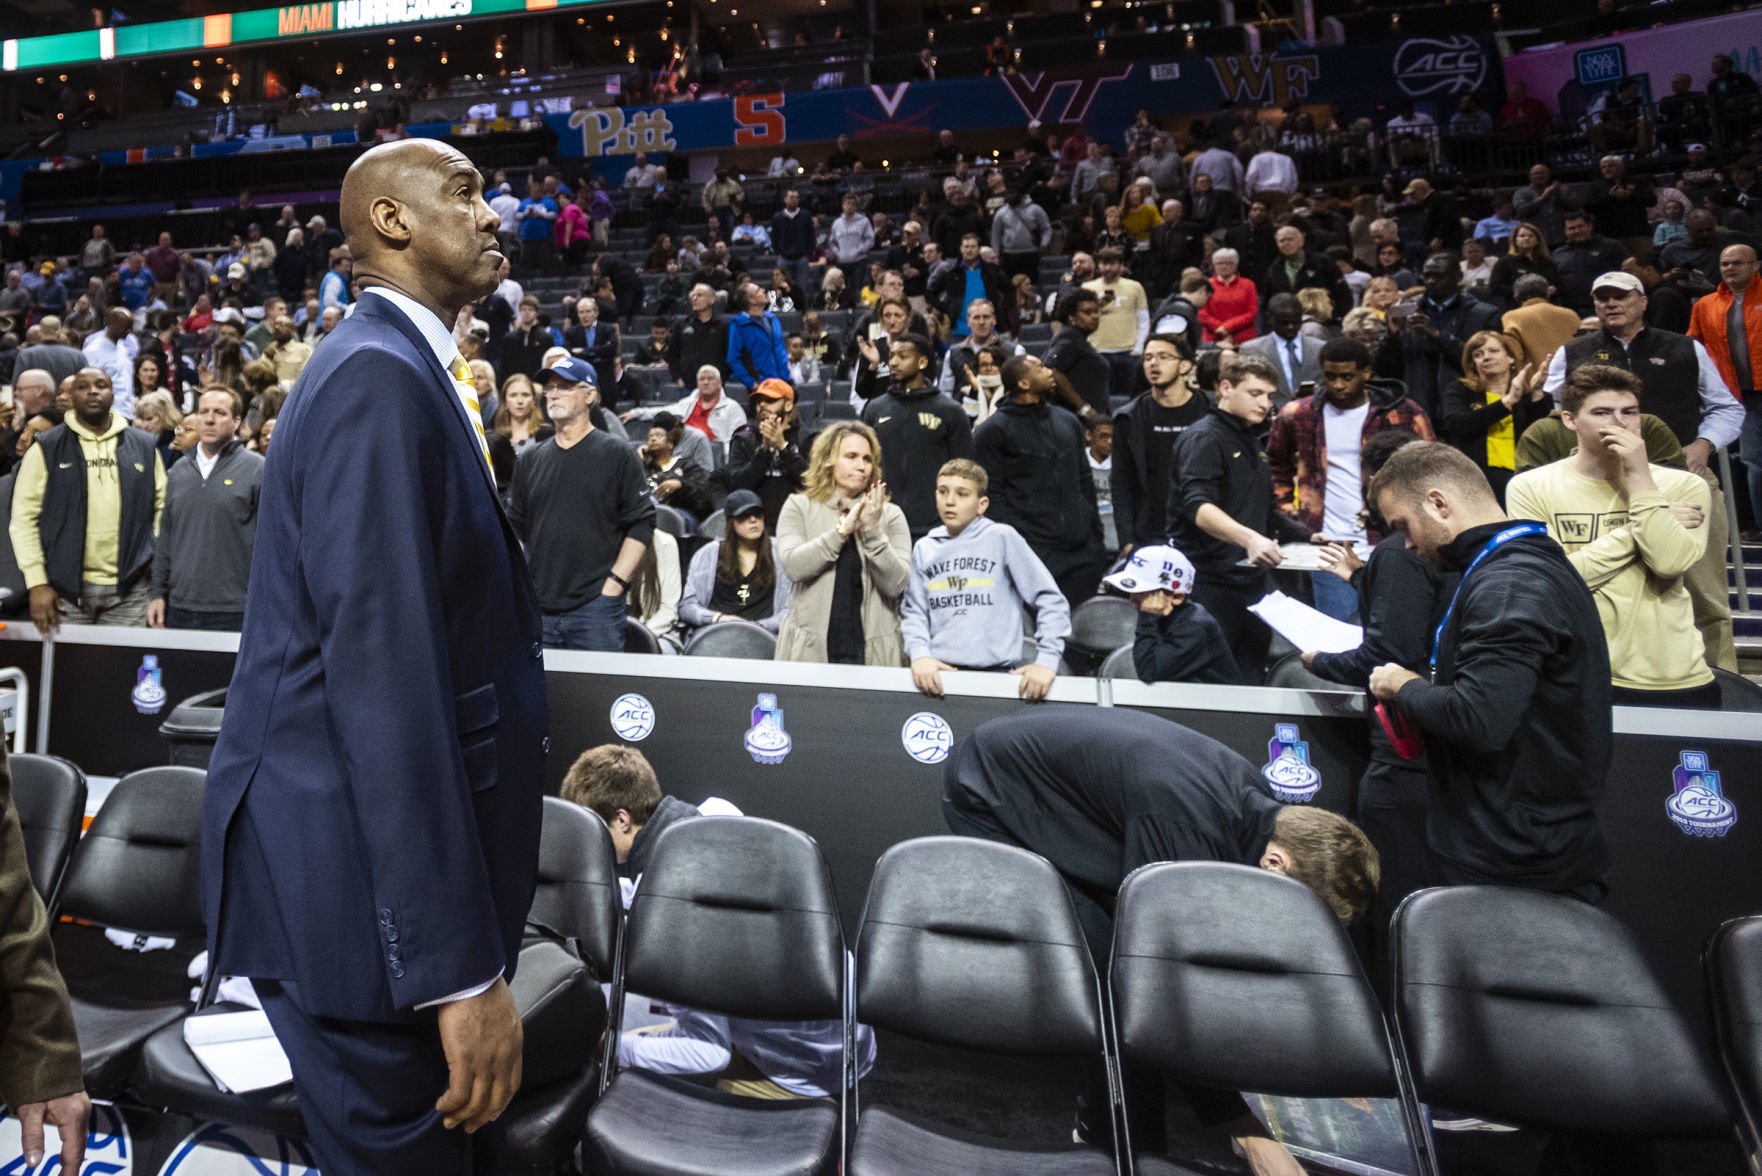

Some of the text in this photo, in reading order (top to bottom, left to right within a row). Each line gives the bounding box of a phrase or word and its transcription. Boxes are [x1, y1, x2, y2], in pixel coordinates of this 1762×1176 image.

[278, 3, 333, 36] MIAMI
[1405, 50, 1480, 73] ACC
[734, 92, 786, 146] S
[568, 106, 677, 157] Pitt
[1560, 520, 1589, 537] WF
[922, 557, 997, 580] WAKE FOREST
[946, 575, 969, 592] WF
[929, 593, 994, 610] BASKETBALL
[617, 710, 650, 720] ACC
[911, 729, 947, 741] ACC
[1280, 766, 1305, 775] ACC
[1686, 797, 1718, 806] ACC
